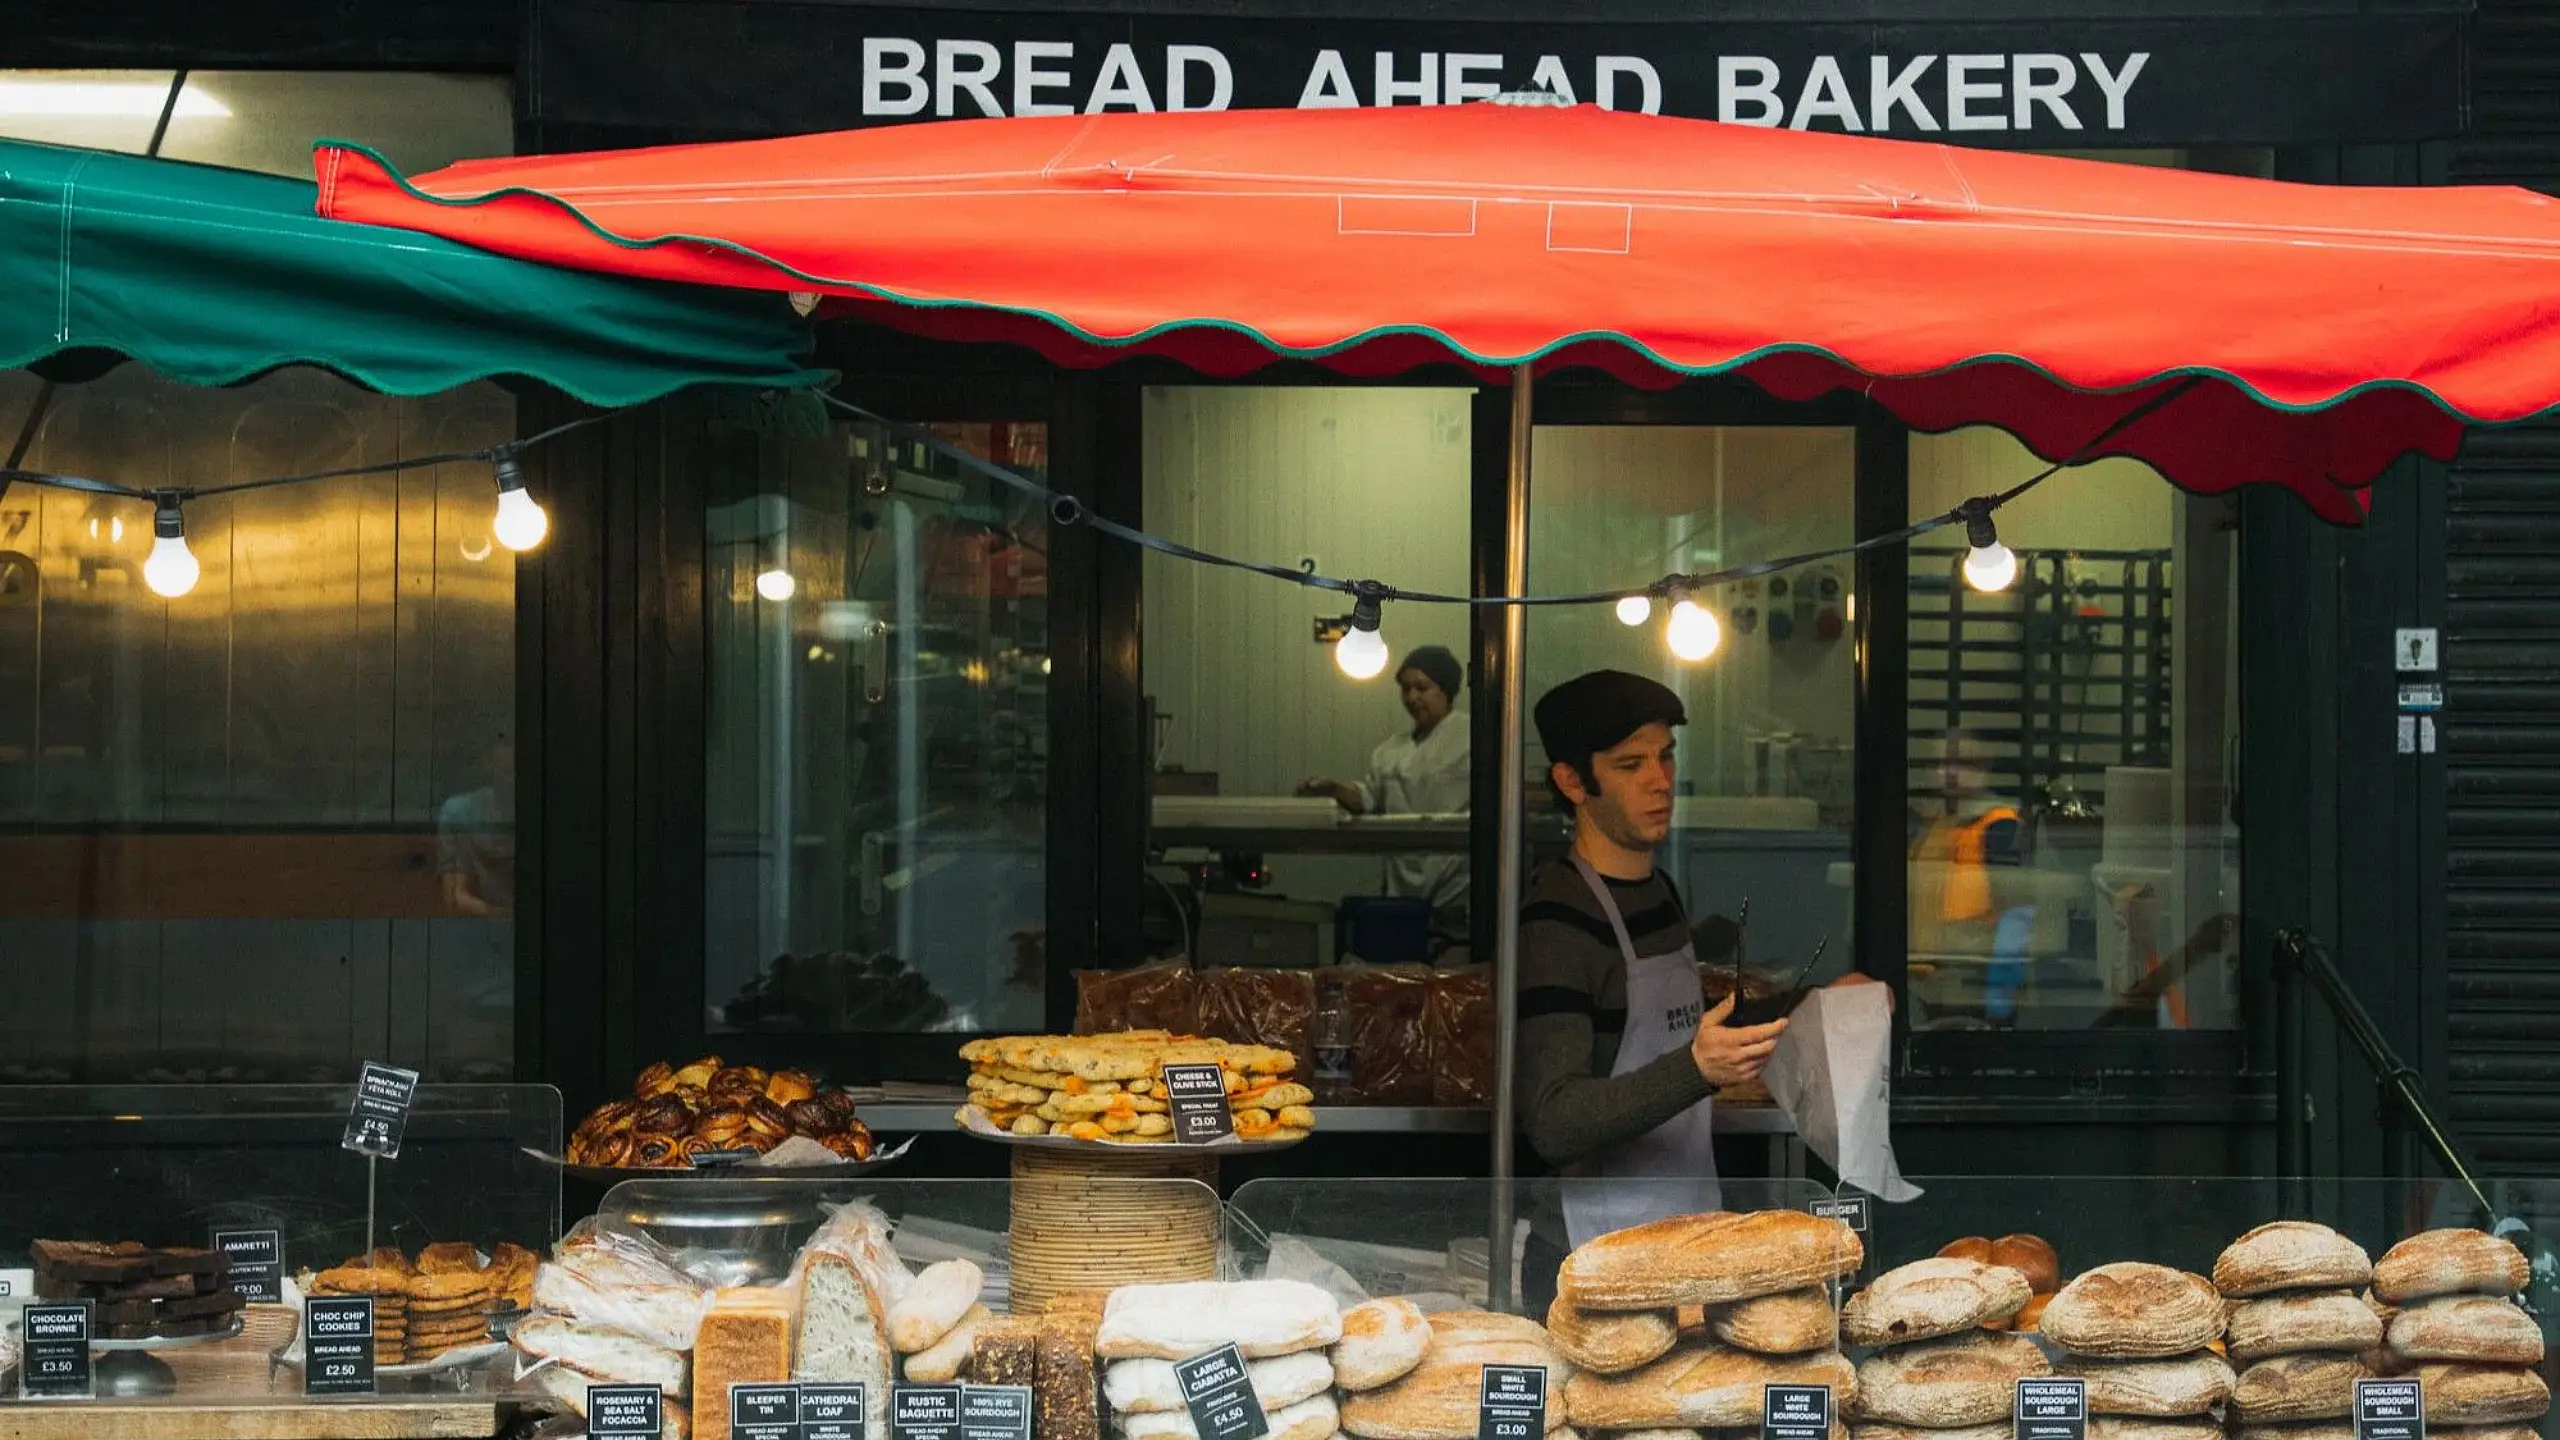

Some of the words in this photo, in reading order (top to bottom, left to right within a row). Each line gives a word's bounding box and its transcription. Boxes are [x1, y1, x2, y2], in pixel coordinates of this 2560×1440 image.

[863, 37, 1233, 118] BREAD
[1297, 49, 1661, 116] AHEAD
[1718, 53, 2150, 131] BAKERY
[1667, 1002, 1700, 1020] BREA
[1668, 1015, 1698, 1032] AHE
[1175, 1072, 1204, 1081] CHEESE
[1173, 1080, 1195, 1089] OLIVE
[1196, 1080, 1218, 1089] STICK
[1190, 1116, 1217, 1127] £3.00
[224, 1241, 270, 1251] AMARETTI
[31, 1314, 85, 1324] CHOCOLATE
[314, 1311, 341, 1321] CHOC
[342, 1311, 366, 1321] CHIP
[36, 1324, 78, 1333] BROWNIE
[318, 1322, 361, 1332] COOKIES
[314, 1346, 337, 1354] BREAD
[338, 1345, 362, 1353] AHEAD
[42, 1360, 73, 1373] £3.50
[326, 1364, 356, 1376] £2.50
[1193, 1357, 1227, 1379] LARGE
[1190, 1366, 1239, 1392] CIABATTA
[1501, 1375, 1526, 1384] SMALL
[1501, 1384, 1525, 1392] WHITE
[2024, 1387, 2078, 1395] WHOLEMEAL
[2364, 1387, 2414, 1395] WHOLEMEAL
[596, 1396, 645, 1405] ROSEMARY
[646, 1396, 654, 1405] &
[746, 1395, 786, 1405] SLEEPER
[800, 1395, 859, 1405] CATHEDRAL
[908, 1396, 946, 1406] RUSTIC
[1489, 1392, 1538, 1401] SOURDOUGH
[1784, 1395, 1811, 1403] LARGE
[2024, 1396, 2078, 1405] SOURDOUGH
[2364, 1396, 2415, 1405] SOURDOUGH
[972, 1398, 994, 1408] 100%
[995, 1399, 1013, 1408] RYE
[1785, 1404, 1809, 1412] WHITE
[604, 1406, 622, 1415] SEA
[623, 1406, 646, 1415] SALT
[759, 1406, 774, 1415] TIN
[816, 1407, 844, 1417] LOAF
[899, 1408, 955, 1419] BAGUETTE
[964, 1408, 1021, 1418] SOURDOUGH
[2037, 1406, 2066, 1415] LARGE
[2376, 1406, 2403, 1415] SMALL
[602, 1415, 648, 1425] FOCACCIA
[1214, 1406, 1244, 1426] £4.50
[1773, 1412, 1821, 1420] SOURDOUGH
[1496, 1424, 1527, 1436] £3.00
